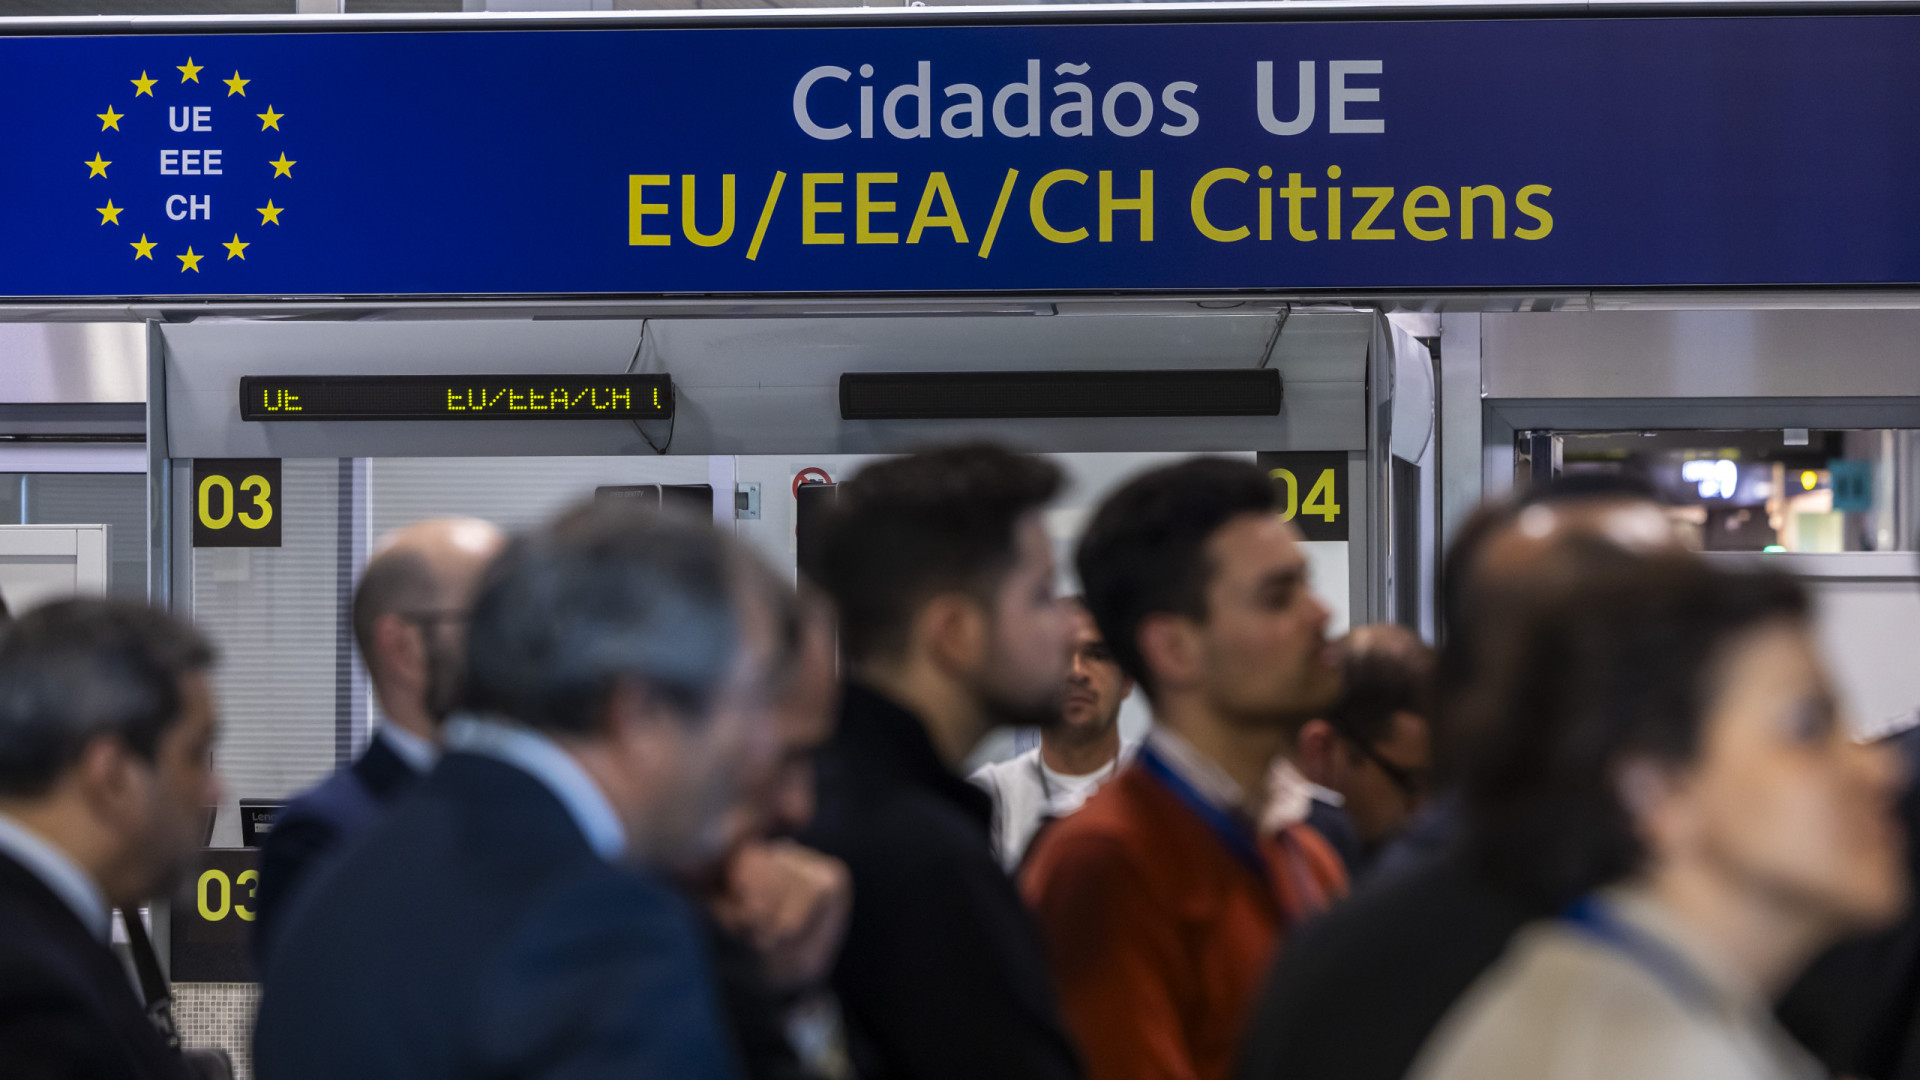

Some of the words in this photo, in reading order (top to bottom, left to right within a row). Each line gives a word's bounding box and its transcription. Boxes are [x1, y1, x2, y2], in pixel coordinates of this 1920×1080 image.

[169, 106, 212, 132] UE
[792, 59, 1200, 140] Cidadãos
[1256, 60, 1385, 135] UE
[160, 149, 223, 175] EEE
[165, 194, 211, 221] CH
[629, 168, 1154, 260] EU/EEA/CH
[1191, 165, 1554, 242] Citizens
[264, 389, 302, 411] UE
[448, 387, 631, 410] EU/EEA/CH
[199, 475, 273, 530] 03
[1269, 468, 1340, 522] 04
[198, 869, 259, 922] 03
